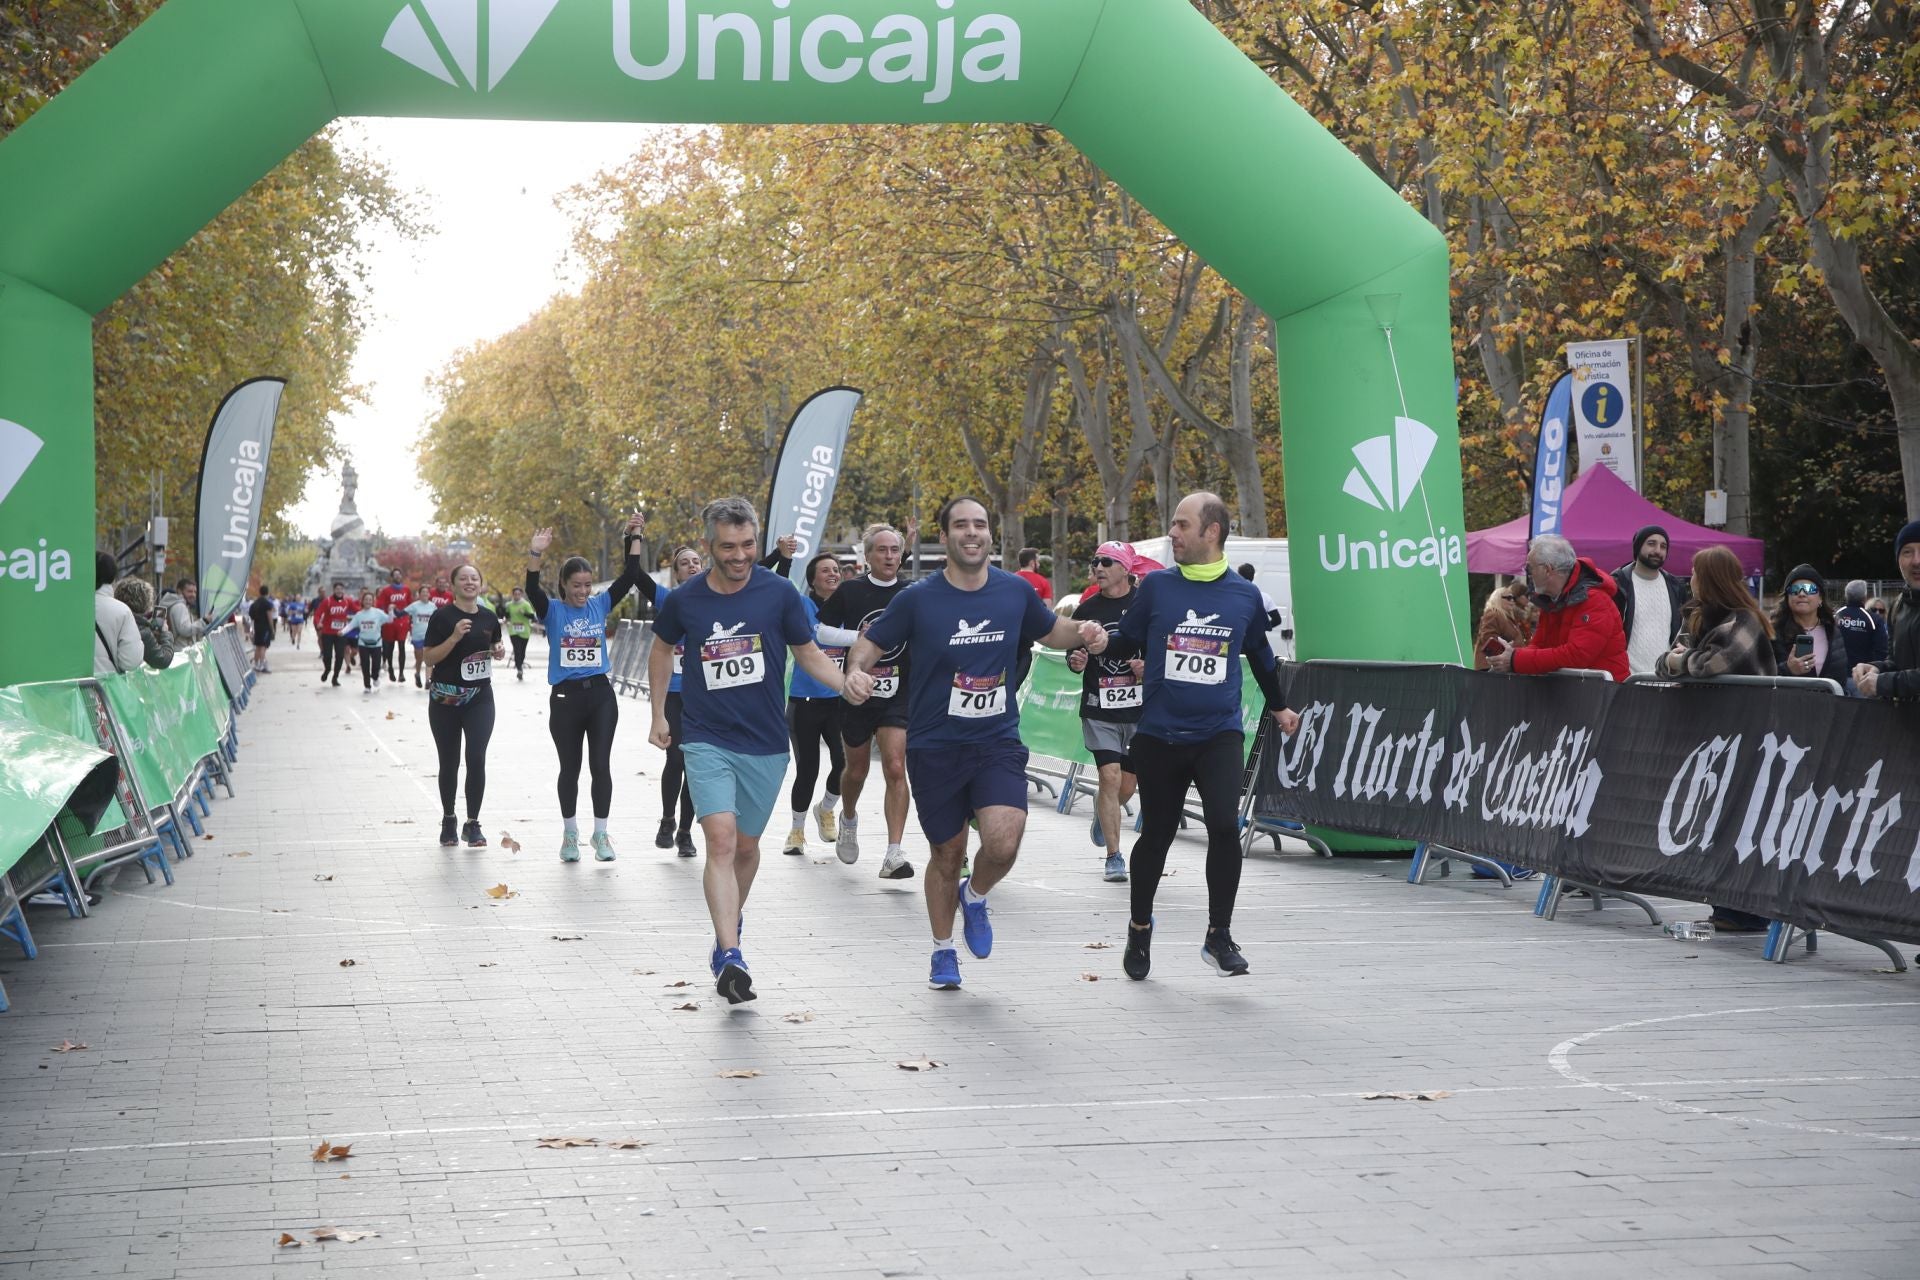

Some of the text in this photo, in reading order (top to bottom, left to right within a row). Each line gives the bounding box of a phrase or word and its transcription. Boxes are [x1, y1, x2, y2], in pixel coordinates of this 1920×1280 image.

[612, 0, 1021, 103] Unicaja
[1575, 348, 1611, 359] Oficina de
[1535, 417, 1564, 537] VECO
[222, 439, 263, 559] Unicaja
[792, 445, 835, 559] Unicaja
[1319, 526, 1461, 577] Unicaja
[0, 538, 71, 592] aja
[949, 634, 1005, 645] MICHELIN
[1175, 627, 1231, 637] MICHELIN
[567, 649, 595, 661] 635
[1174, 653, 1216, 675] 708
[467, 661, 486, 675] 973
[711, 656, 755, 679] 709
[873, 679, 892, 691] 23
[1106, 688, 1137, 702] 624
[1278, 700, 1334, 792] El
[1333, 702, 1445, 804] Norte
[1443, 717, 1486, 813] de
[1658, 733, 1742, 856] El
[1734, 731, 1902, 886] Norte
